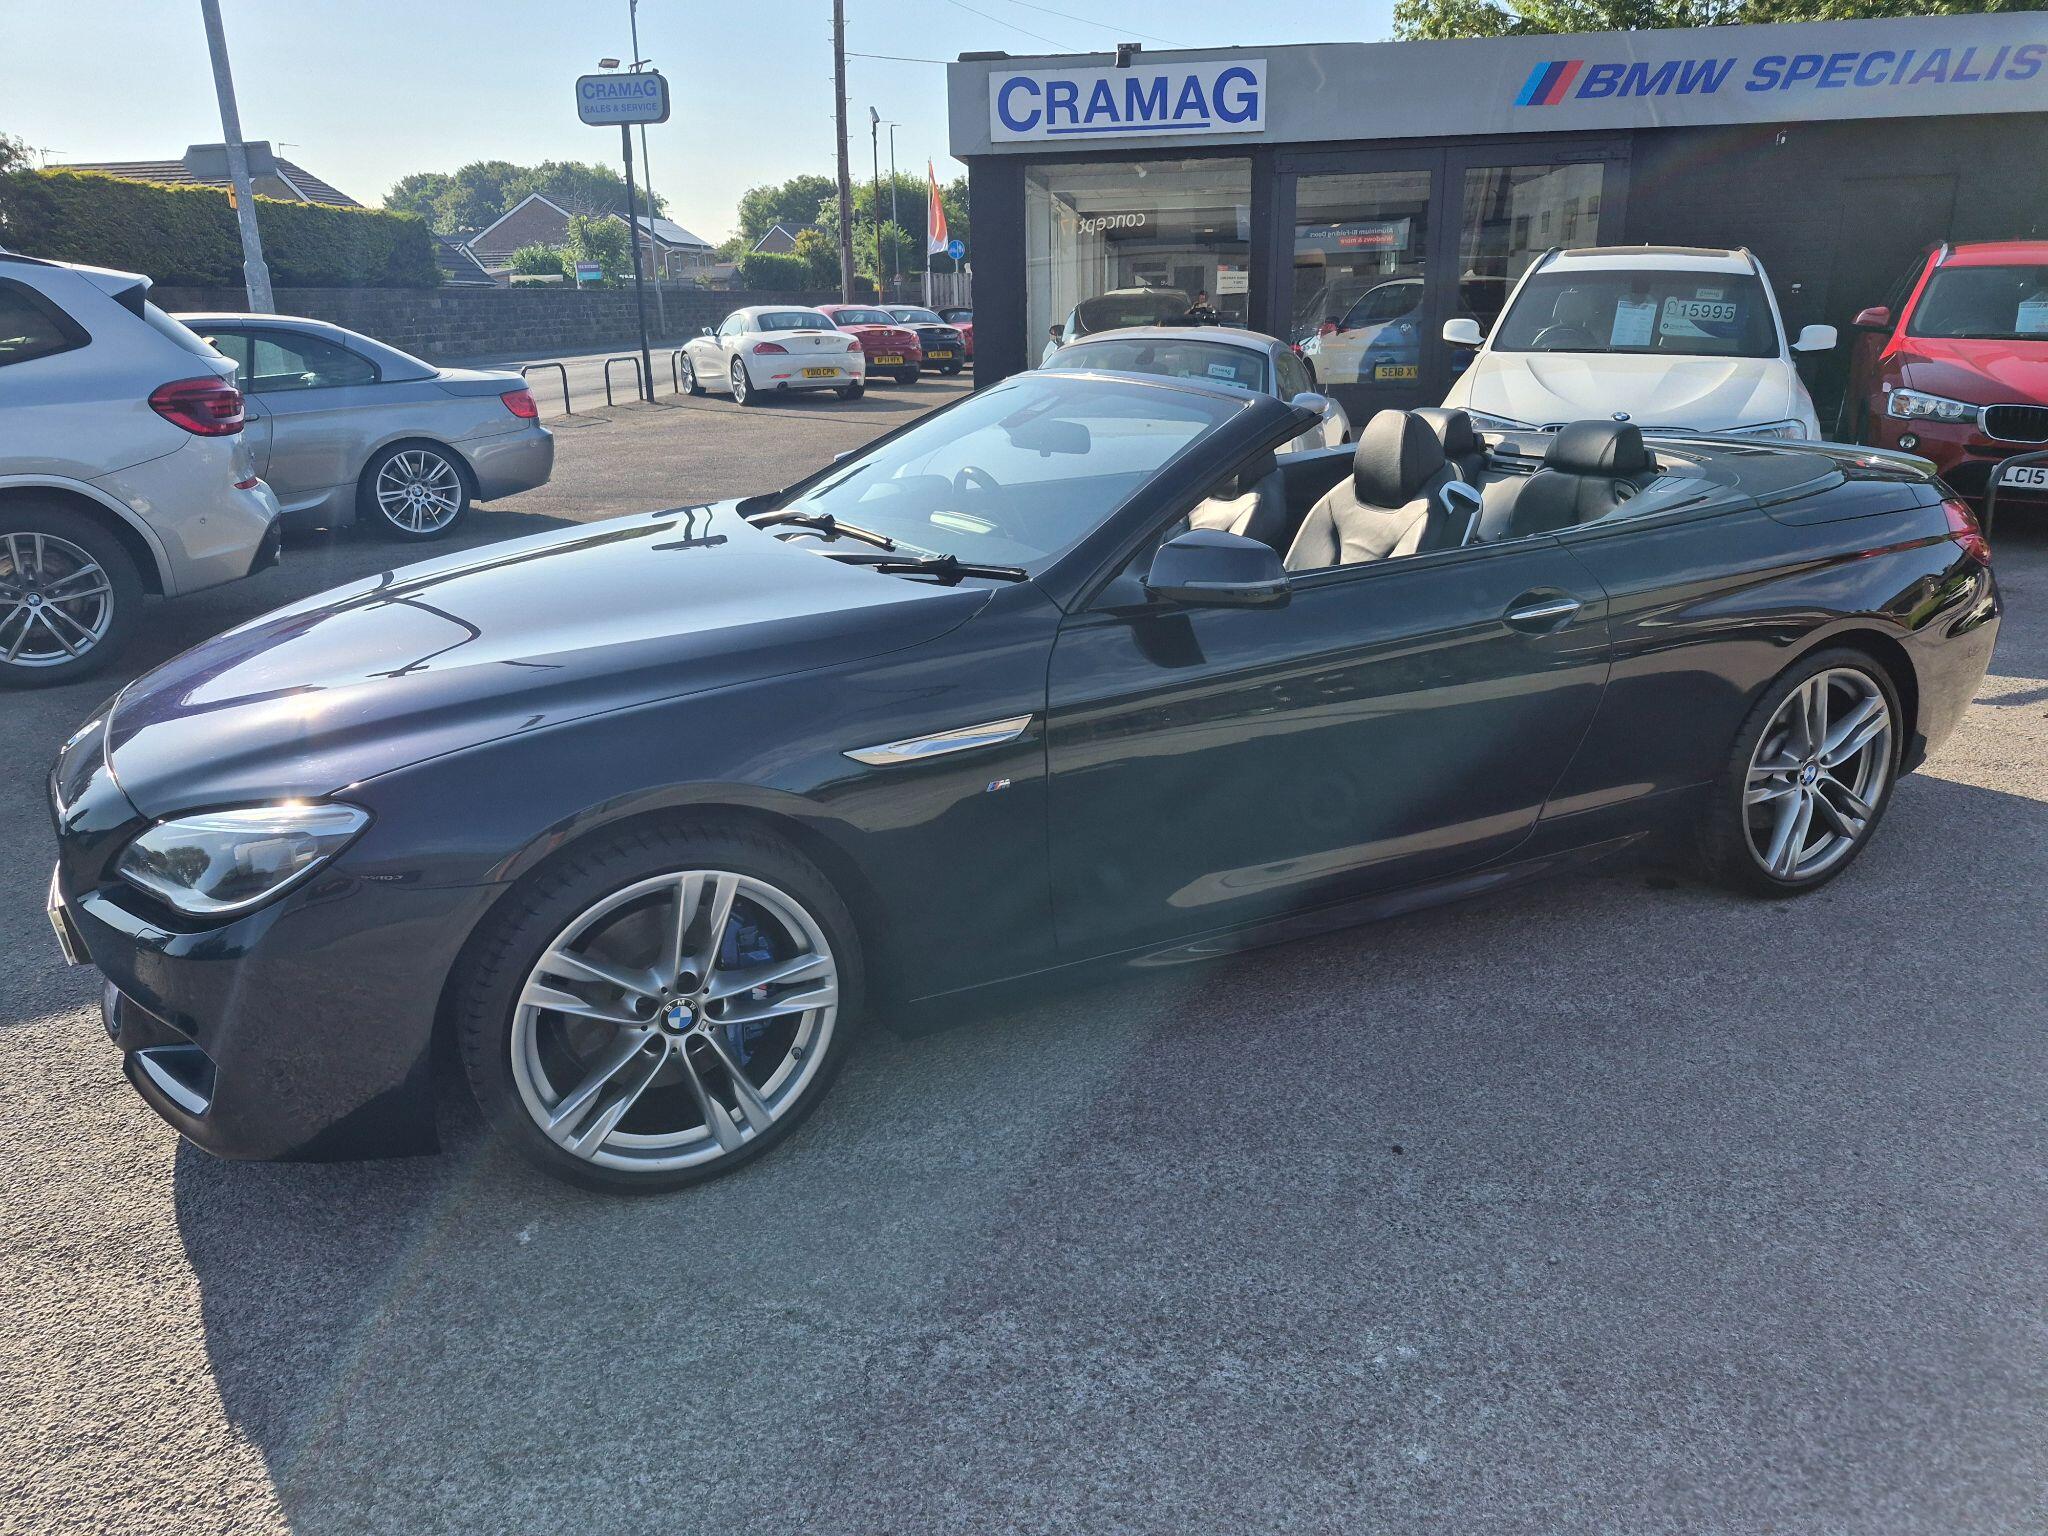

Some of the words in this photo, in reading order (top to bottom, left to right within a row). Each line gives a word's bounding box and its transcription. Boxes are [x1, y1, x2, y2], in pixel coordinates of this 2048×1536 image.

[1575, 58, 1738, 99] BMW
[1745, 43, 2047, 92] SPECIALIS
[582, 79, 657, 100] CRAMAG
[998, 66, 1258, 132] CRAMAG
[584, 104, 611, 114] SALES
[613, 104, 619, 112] &
[621, 102, 657, 112] SERVICE
[1382, 367, 1404, 377] SE18
[2001, 468, 2046, 484] LC15
[665, 999, 697, 1012] BMW
